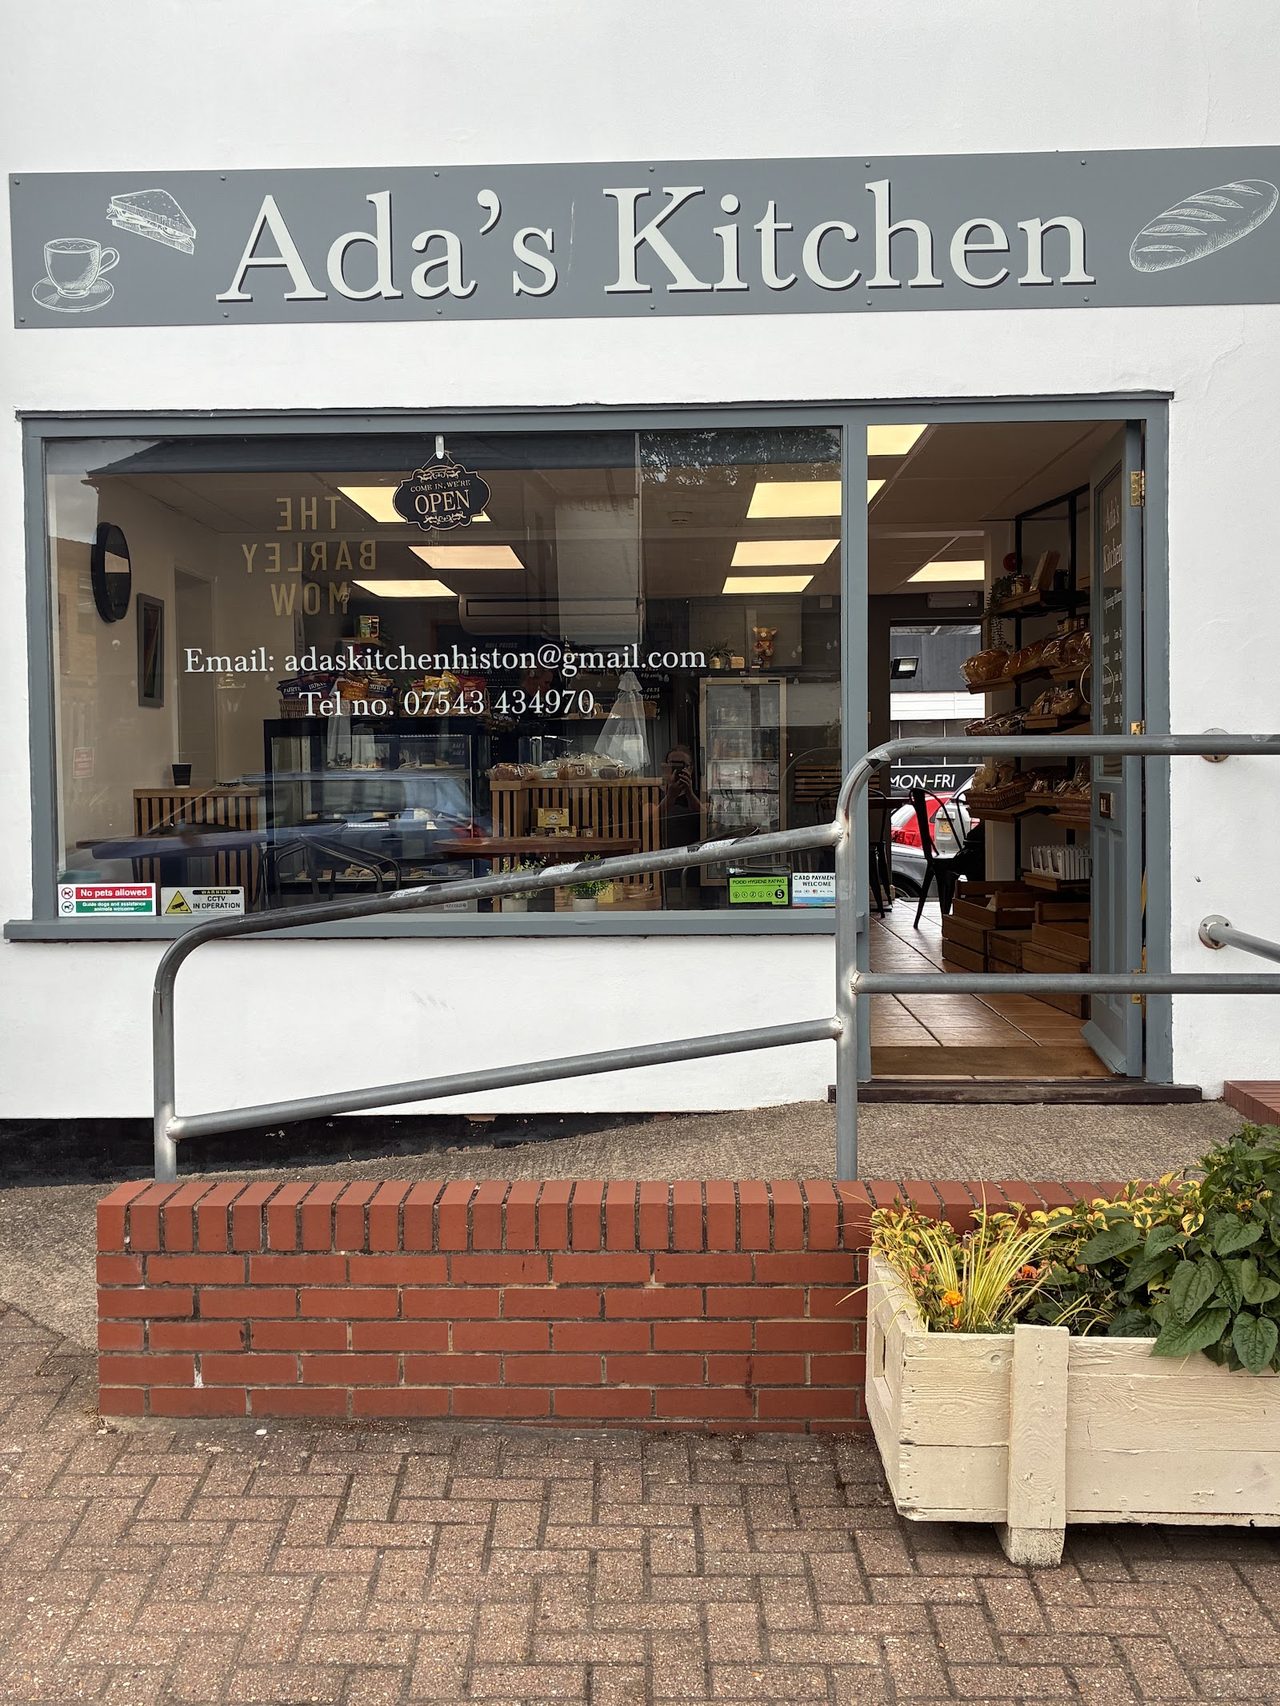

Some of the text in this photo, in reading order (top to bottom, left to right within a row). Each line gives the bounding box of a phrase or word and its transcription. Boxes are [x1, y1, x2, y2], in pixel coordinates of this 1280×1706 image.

[215, 178, 1097, 303] Ada's Kitchen
[410, 484, 434, 493] COME
[414, 489, 471, 515] OPEN
[183, 643, 707, 678] Email: adaskitchenhiston@gmail.com
[298, 690, 342, 717] Tel
[352, 698, 395, 717] no.
[403, 689, 485, 716] 07543
[494, 688, 595, 714] 434970
[890, 774, 955, 788] MON-FRI
[80, 888, 148, 898] No pets allowed
